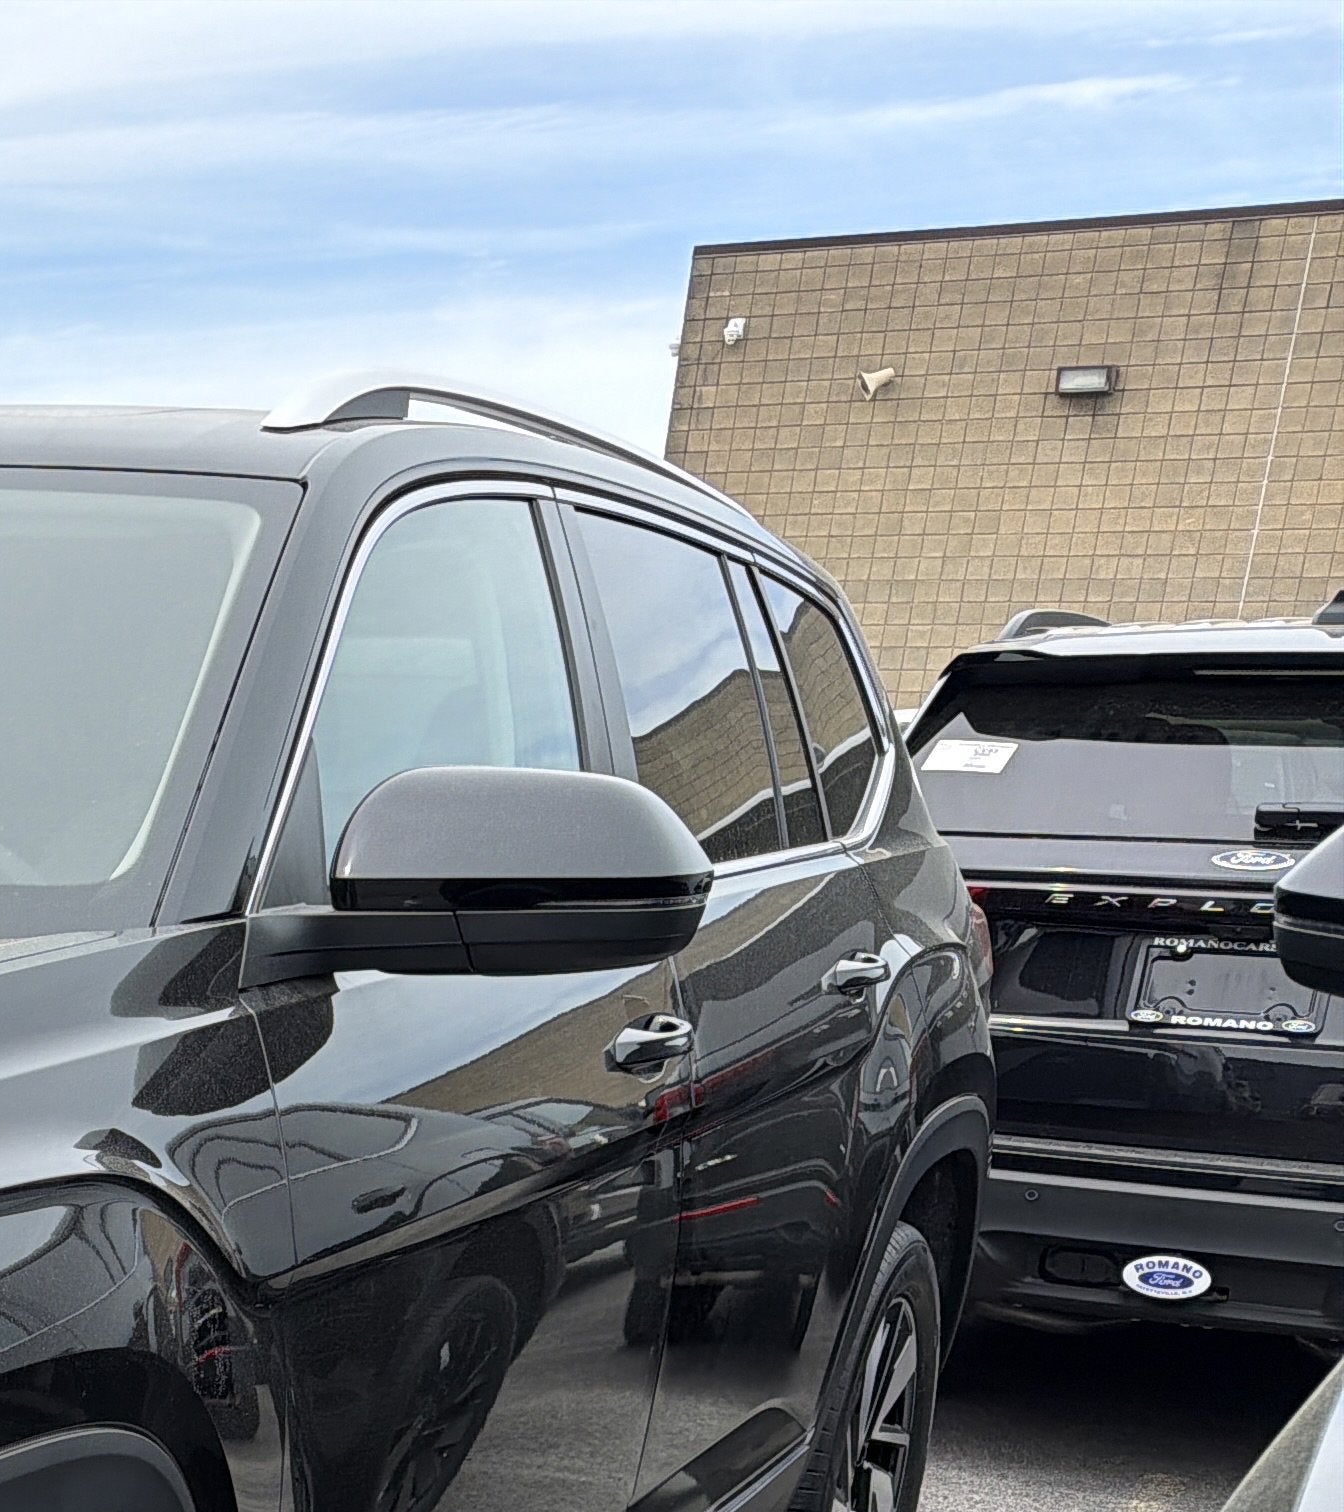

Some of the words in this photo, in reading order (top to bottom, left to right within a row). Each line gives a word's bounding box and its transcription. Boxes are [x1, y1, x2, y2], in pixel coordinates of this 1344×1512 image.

[1170, 1015, 1274, 1031] ROMANO
[1133, 1259, 1204, 1279] ROMANO
[1148, 1272, 1185, 1288] Ford
